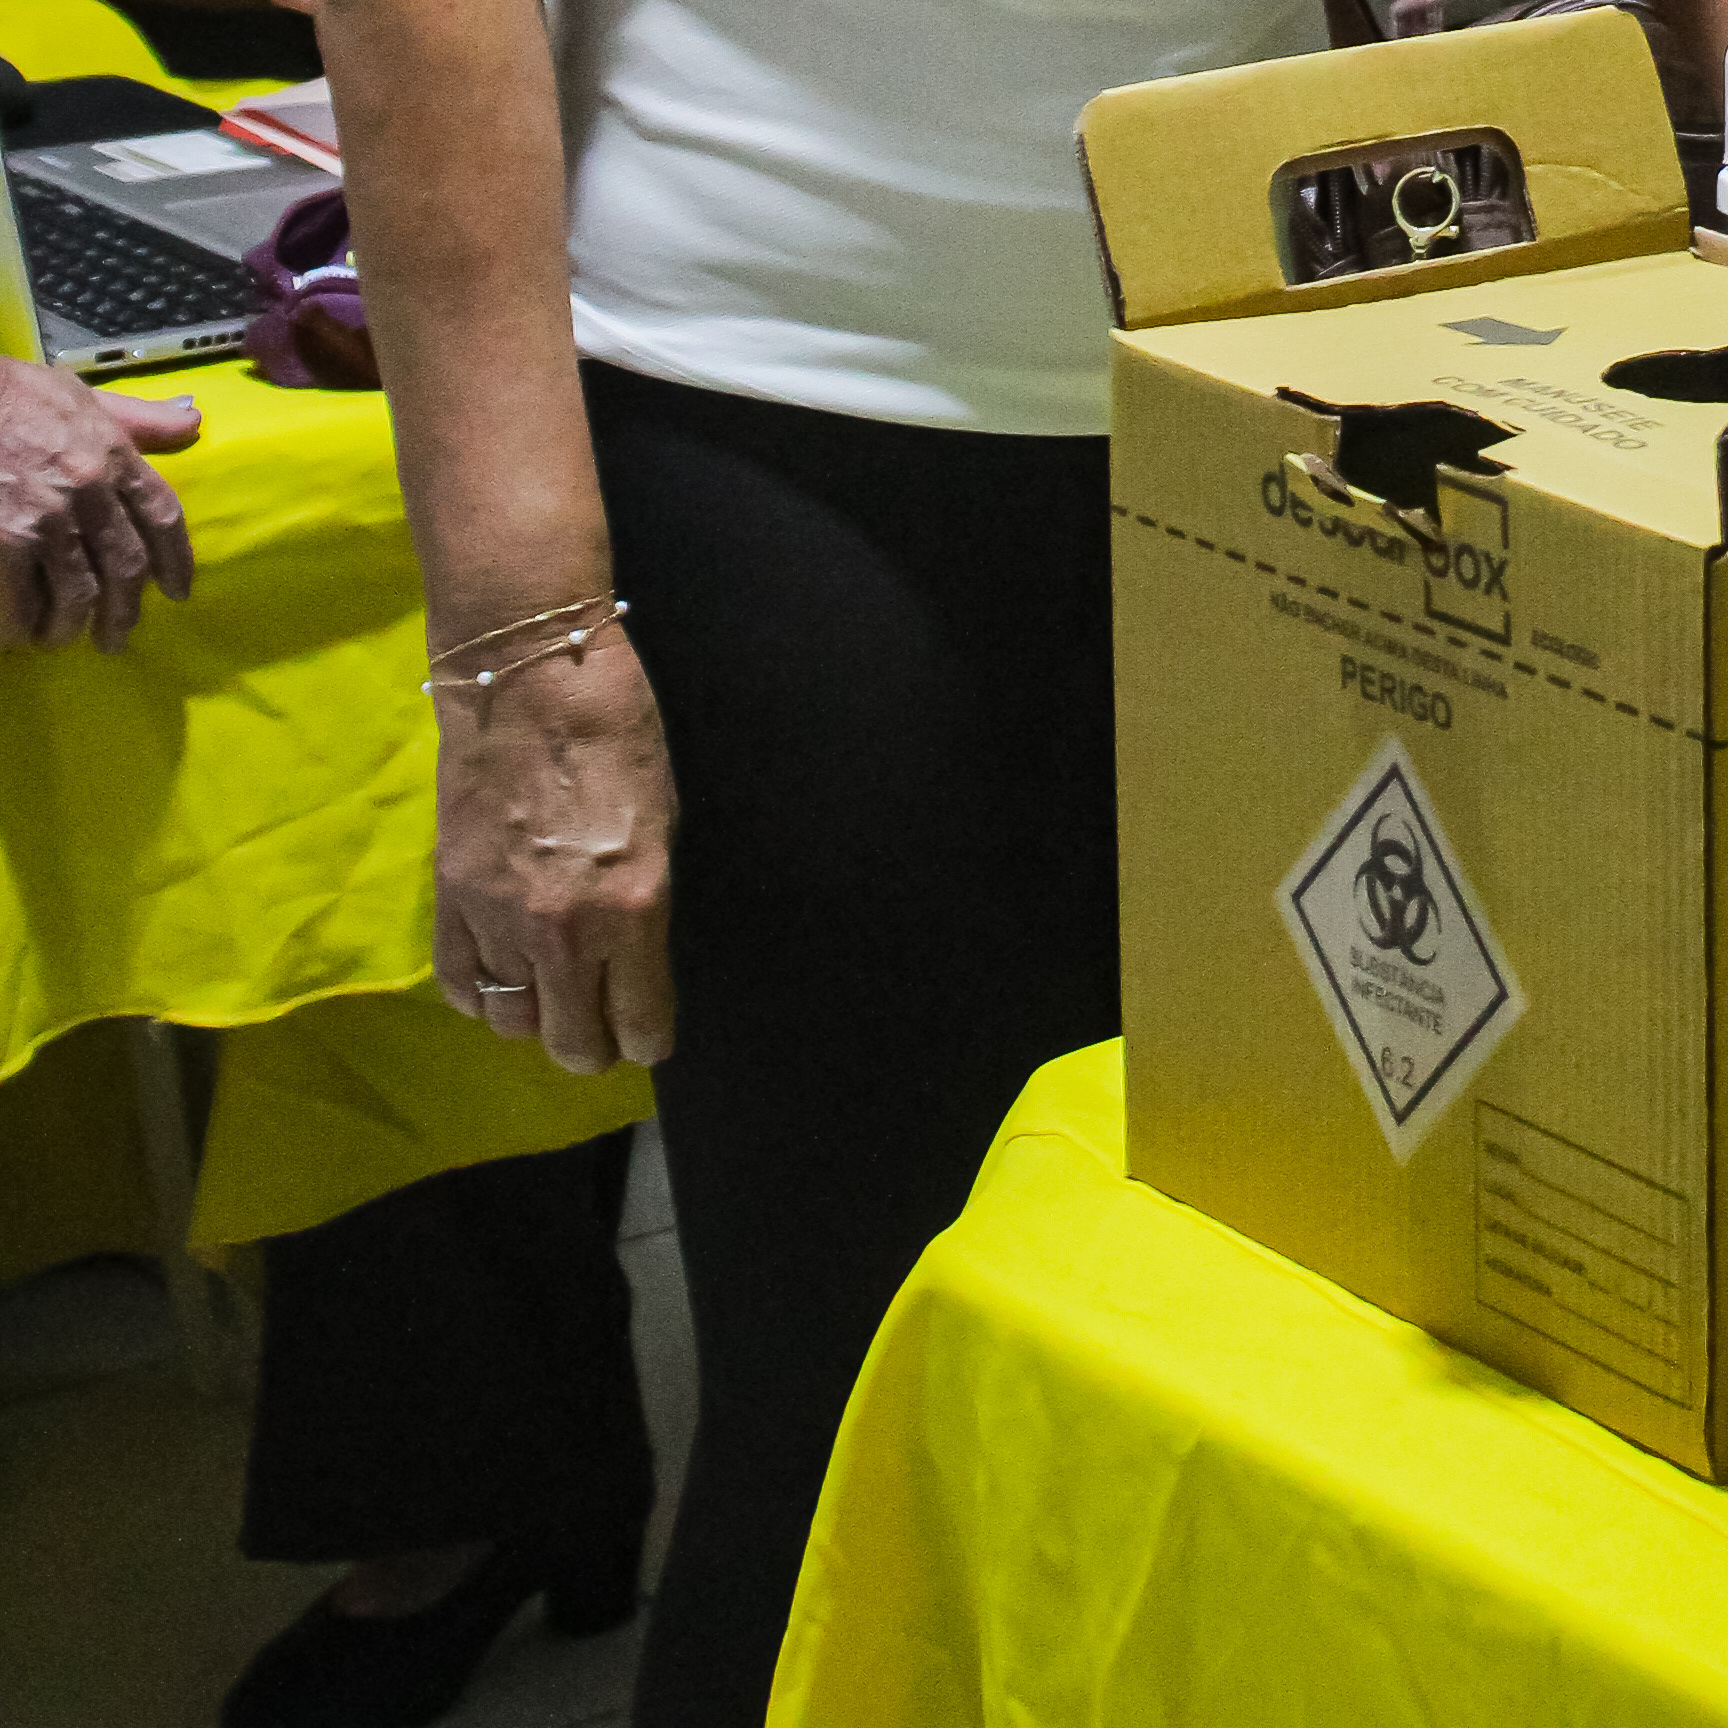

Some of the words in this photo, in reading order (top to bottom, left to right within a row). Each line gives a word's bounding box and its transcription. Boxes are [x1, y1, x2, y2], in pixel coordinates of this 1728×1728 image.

[1431, 374, 1505, 399] COM
[1503, 396, 1650, 451] CUIDADO
[1498, 376, 1663, 432] MANUSEIE
[1340, 654, 1453, 729] PERIGO
[1381, 1046, 1414, 1088] 6.2
